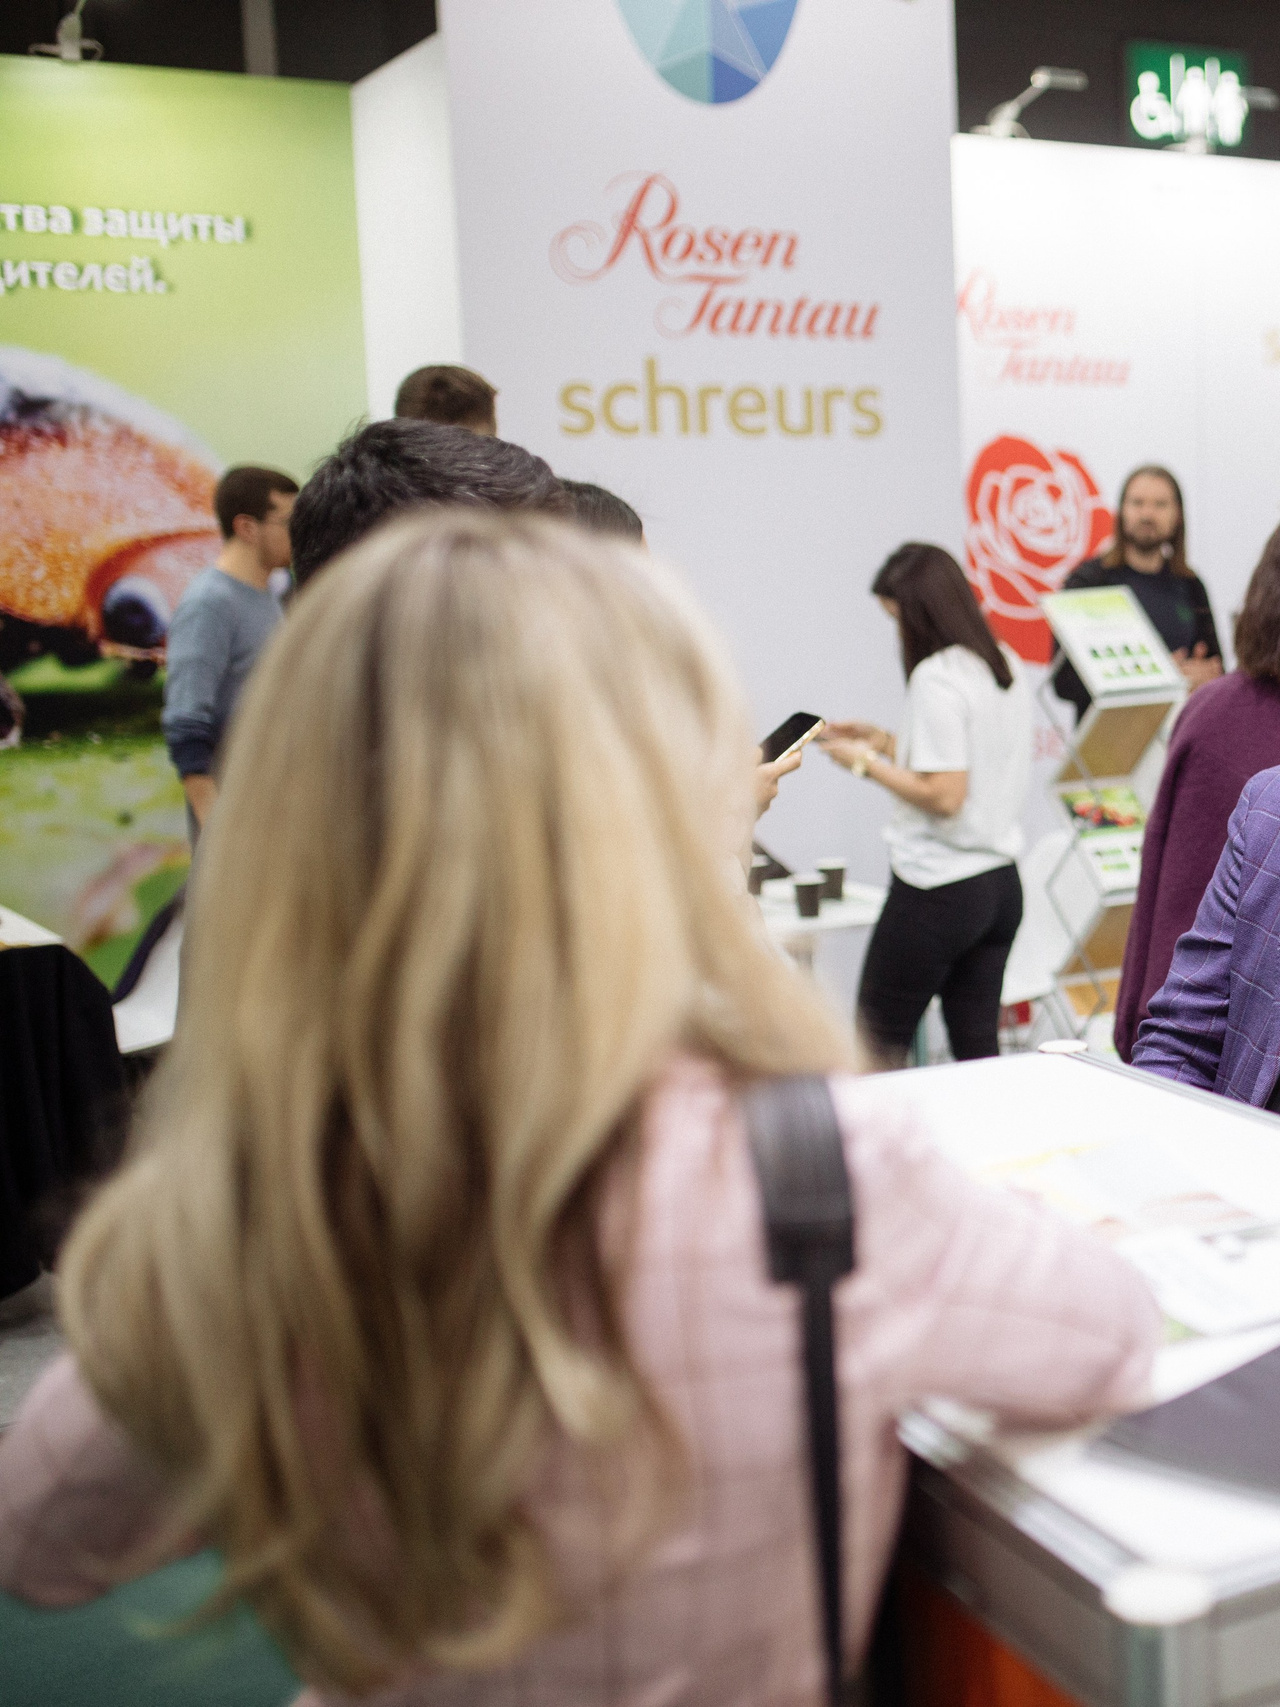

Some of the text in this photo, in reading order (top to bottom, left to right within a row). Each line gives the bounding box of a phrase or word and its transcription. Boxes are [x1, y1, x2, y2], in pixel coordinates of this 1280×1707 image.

[83, 206, 246, 248] защиты
[549, 170, 799, 285] Rosen
[0, 255, 167, 294] ителей.
[653, 272, 880, 340] Tantau
[559, 356, 884, 437] schreurs
